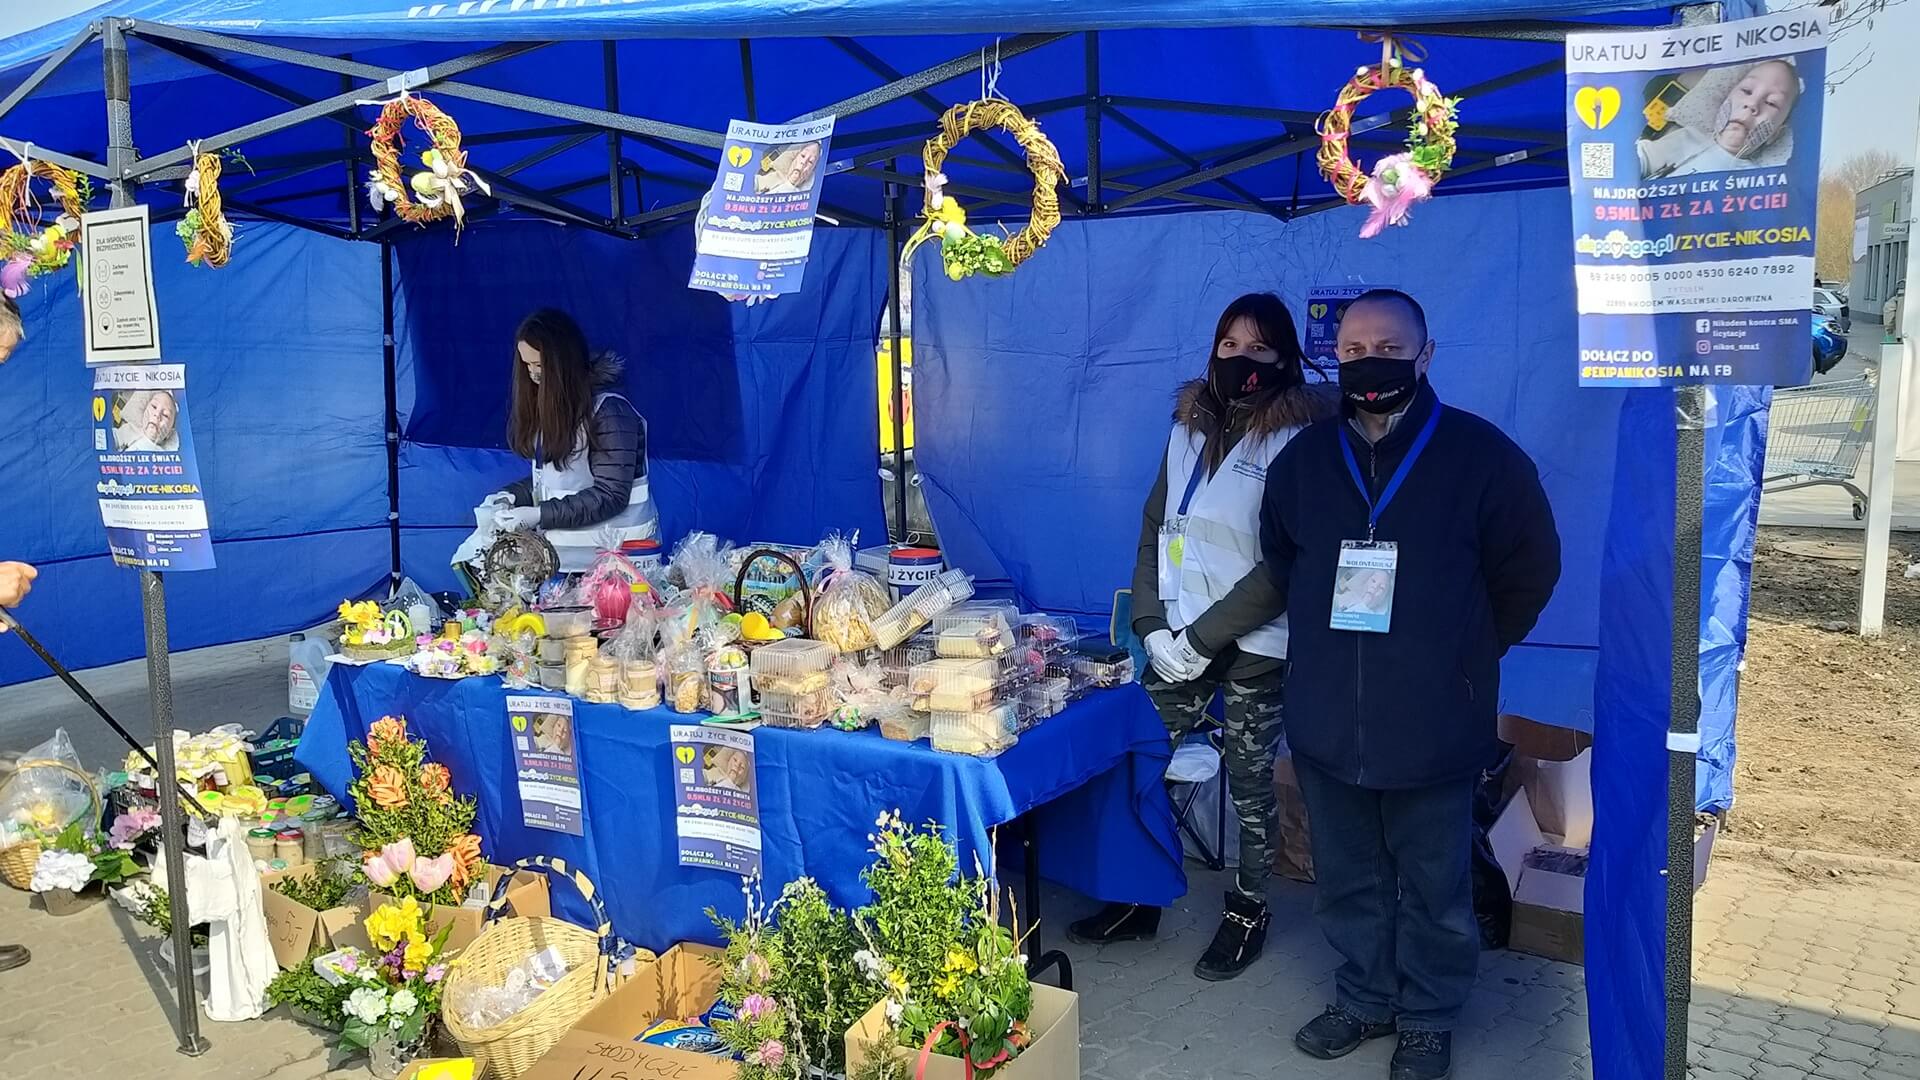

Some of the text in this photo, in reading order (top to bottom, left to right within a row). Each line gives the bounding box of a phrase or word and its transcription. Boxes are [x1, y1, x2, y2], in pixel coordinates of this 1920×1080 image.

[1572, 20, 1821, 61] URATUJ ŻYCIE NIKOSIA
[732, 126, 769, 138] URATUJ
[803, 124, 831, 136] NIKOSIA
[1593, 173, 1788, 200] NAJDROŻSZY LEK ŚWIATA
[1660, 204, 1683, 218] ZŁ
[1690, 200, 1714, 216] ZA
[1630, 273, 1660, 282] 0005
[1664, 270, 1692, 280] 0000
[1696, 268, 1724, 278] 4530
[1728, 266, 1758, 276] 6240
[1763, 264, 1794, 274] 7892
[1722, 295, 1773, 304] DAROWIZNA
[1778, 318, 1799, 326] SMA
[1580, 350, 1654, 364] DOŁĄCZ DO
[145, 371, 182, 381] NIKOSIA
[1690, 365, 1710, 376] NA
[1714, 364, 1732, 376] FB
